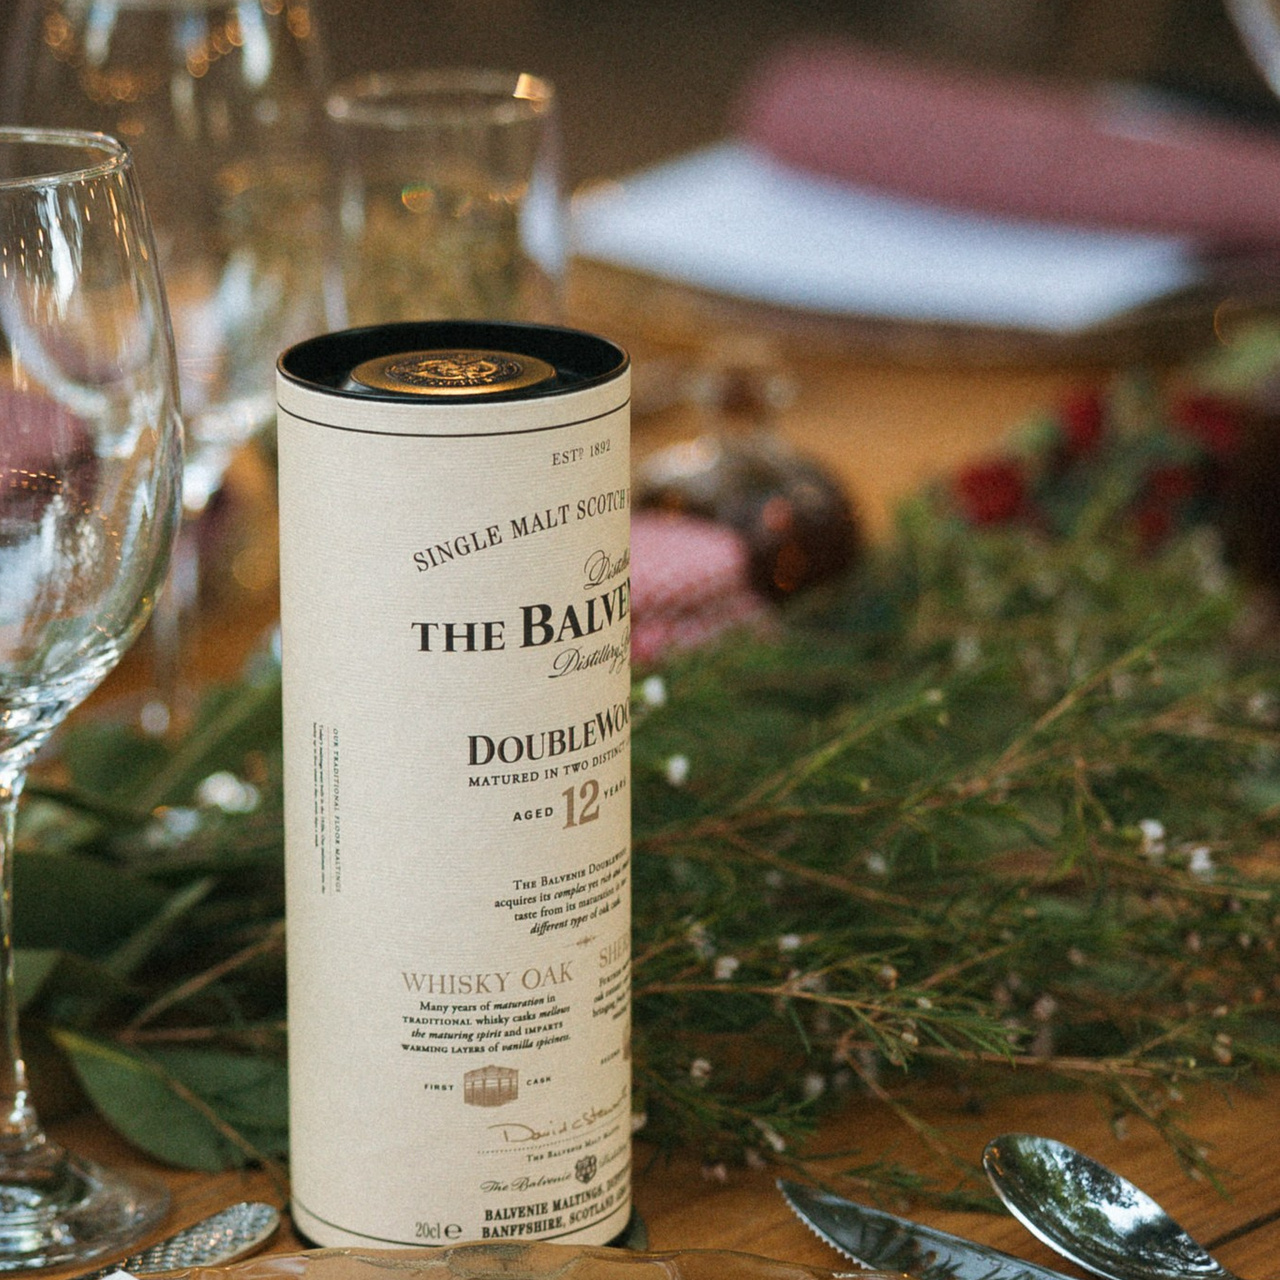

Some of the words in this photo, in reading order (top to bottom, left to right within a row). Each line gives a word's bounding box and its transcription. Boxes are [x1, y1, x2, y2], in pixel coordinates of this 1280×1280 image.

[590, 438, 611, 458] 1892
[413, 524, 503, 572] SINGLE
[510, 504, 570, 539] MALT
[577, 488, 625, 520] SCOTCH
[411, 620, 506, 653] THE
[469, 771, 539, 787] MATURED
[545, 767, 558, 780] IN
[563, 760, 589, 776] TWO
[513, 807, 553, 822] AGED
[561, 779, 599, 830] 12
[541, 869, 586, 887] BALVENIE
[494, 895, 537, 910] acquires
[540, 892, 551, 902] its
[514, 910, 538, 921] taste
[540, 906, 563, 918] from
[566, 902, 576, 912] its
[530, 919, 568, 936] different
[401, 972, 511, 995] WHISKY
[521, 960, 573, 990] OAK
[420, 1001, 448, 1014] Many
[452, 1003, 477, 1014] years
[480, 1001, 491, 1011] of
[493, 997, 545, 1010] maturation
[546, 994, 556, 1003] in
[402, 1016, 472, 1026] TRADITIONAL
[475, 1014, 510, 1027] whisky
[512, 1011, 536, 1023] casks
[411, 1028, 426, 1039] the
[428, 1029, 474, 1042] maturing
[476, 1029, 502, 1042] spirit
[504, 1026, 522, 1038] and
[401, 1043, 448, 1054] WARMING
[451, 1045, 485, 1054] LAYERS
[488, 1040, 499, 1053] of
[502, 1039, 534, 1052] vanilla
[424, 1084, 455, 1092] FIRST
[479, 1180, 509, 1193] The
[511, 1171, 573, 1192] Balvenie
[485, 1202, 549, 1221] BALVENIE
[415, 1222, 441, 1239] 20cl
[482, 1216, 566, 1238] BANFFSHIRE,
